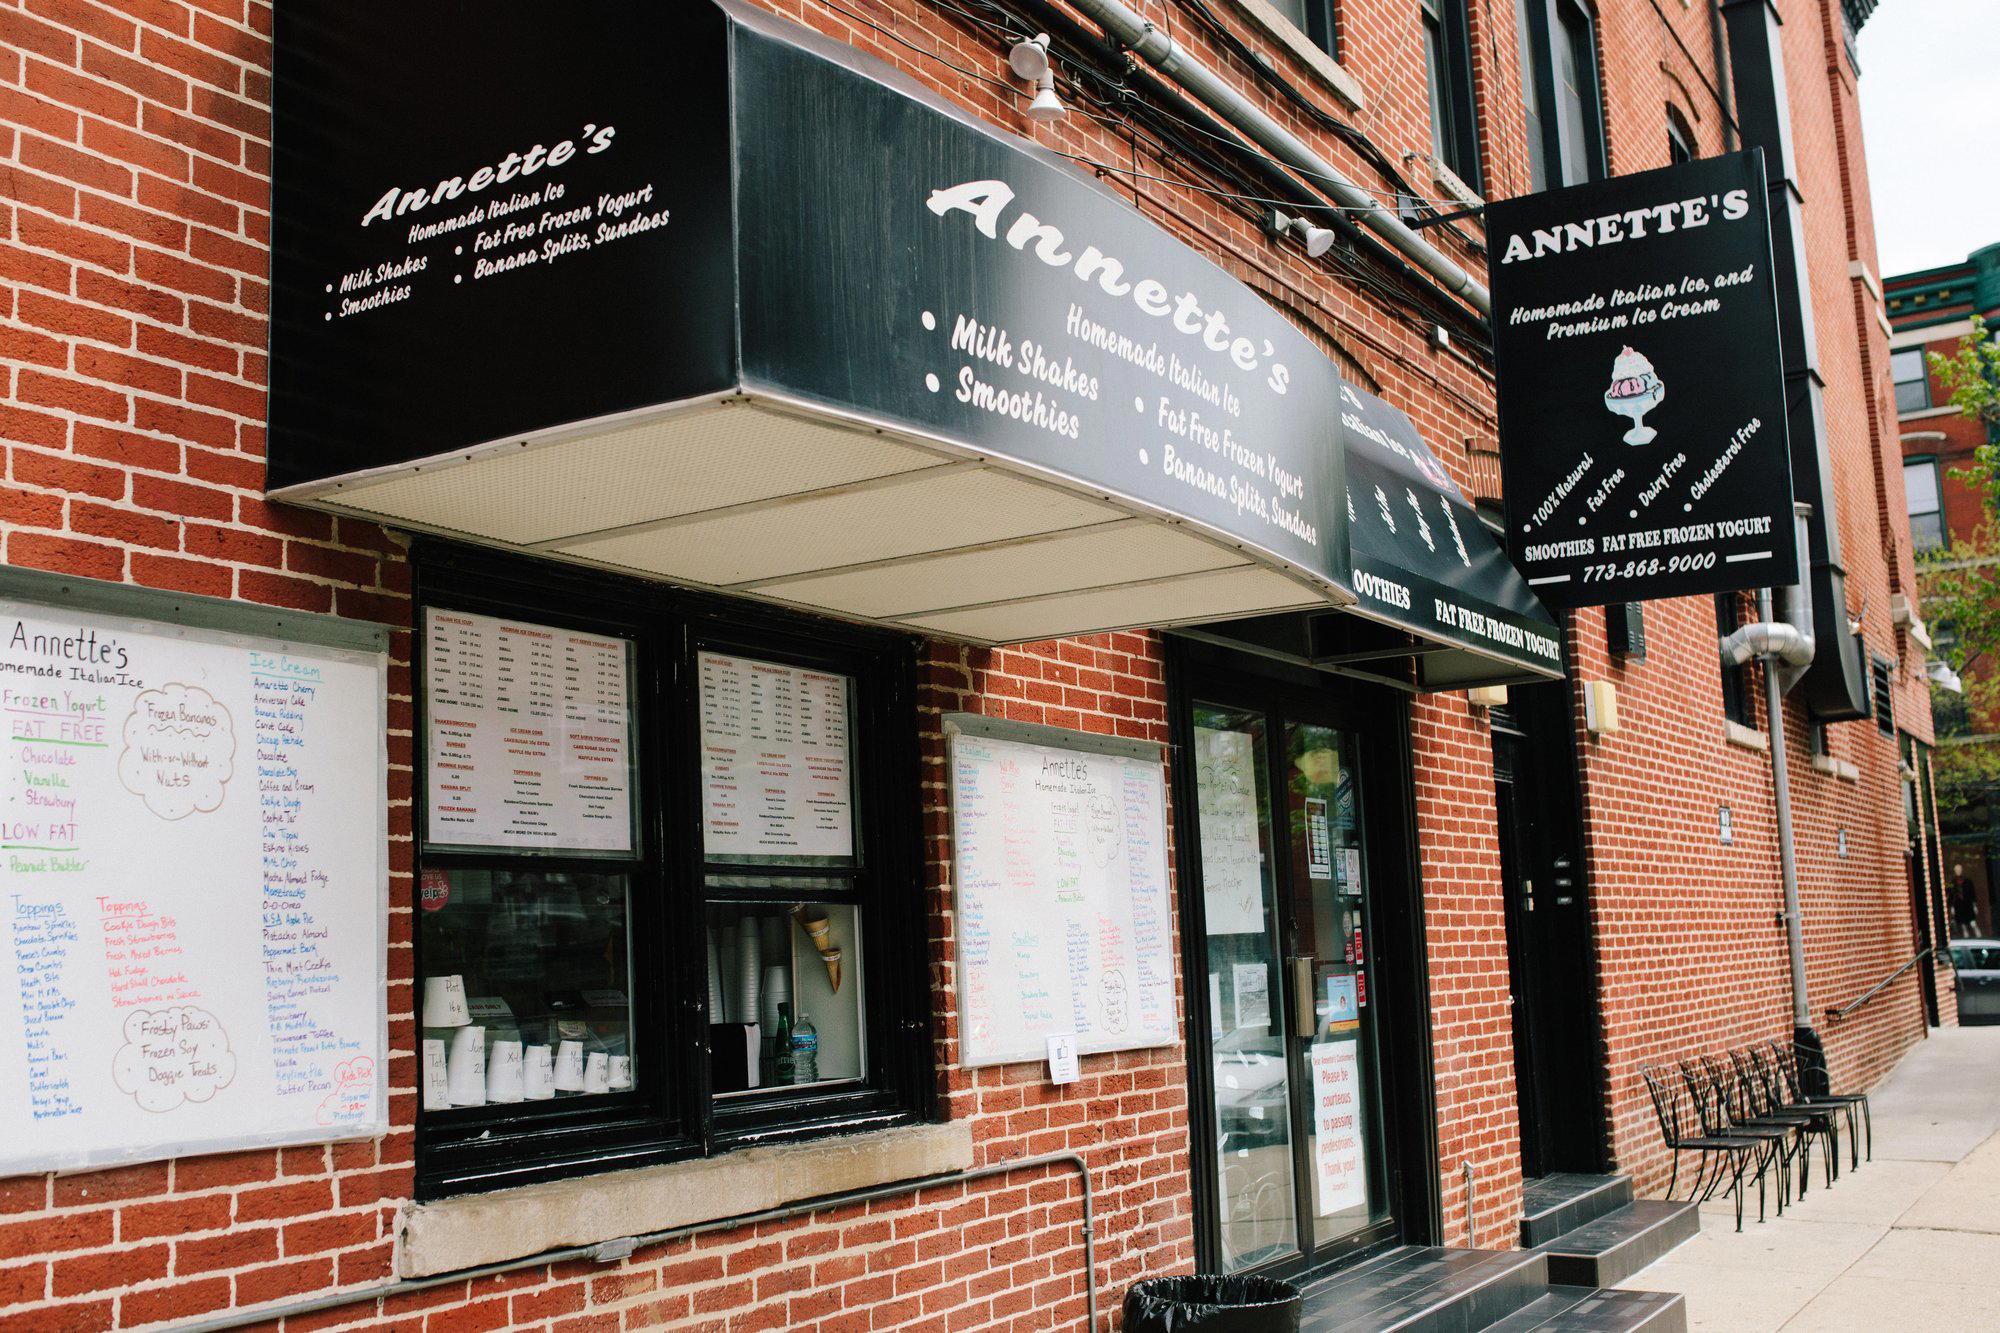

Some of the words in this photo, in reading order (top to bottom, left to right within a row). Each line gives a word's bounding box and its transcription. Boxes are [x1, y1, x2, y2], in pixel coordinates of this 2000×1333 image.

[361, 123, 615, 227] Annette's
[408, 210, 484, 243] Homemade
[487, 189, 541, 220] Italian
[543, 182, 565, 203] Ice
[474, 231, 501, 253] Fat
[503, 219, 535, 244] Free
[538, 203, 592, 234] Frozen
[597, 183, 653, 221] Yogurt
[1501, 189, 1749, 265] ANNETTE'S
[474, 249, 538, 279] Banana
[541, 233, 591, 263] Splits,
[594, 209, 670, 245] Sundaes
[340, 274, 372, 294] Milk
[375, 255, 428, 284] Shakes
[926, 179, 1291, 395] Annette's
[1509, 293, 1605, 326] Homemade
[1610, 284, 1676, 308] Italian
[1680, 276, 1709, 294] Ice,
[1714, 264, 1753, 289] and
[339, 284, 411, 317] Smoothies
[1547, 316, 1628, 341] Premium
[1632, 307, 1657, 326] Ice
[1660, 296, 1721, 321] Cream
[951, 314, 1013, 369] Milk
[1017, 339, 1099, 401] Shakes
[1066, 303, 1165, 377] Homemade
[1169, 353, 1220, 407] Italian
[1223, 384, 1240, 417] Ice
[955, 366, 1080, 440] Smoothies
[1158, 396, 1187, 436] Fat
[1189, 412, 1219, 452] Free
[1222, 429, 1265, 478] Frozen
[1267, 453, 1304, 500] Yogurt
[1689, 437, 1742, 500] Cholesterol
[1736, 416, 1761, 445] Free
[1163, 444, 1226, 499] Banana
[1229, 475, 1269, 525] Splits,
[1271, 497, 1317, 546] Sundaes
[1531, 492, 1560, 527] 100%
[1555, 452, 1594, 499] Natural
[1586, 490, 1603, 513] Fat
[1601, 467, 1626, 495] Free
[1638, 473, 1669, 507] Dairy
[1662, 452, 1687, 482] Free
[1524, 538, 1595, 562] SMOOTHIES
[1602, 533, 1626, 552] FAT
[1628, 529, 1661, 549] FREE
[1663, 523, 1715, 545] FROZEN
[1717, 516, 1772, 539] YOGURT
[1583, 551, 1717, 583] 773-868-9000
[1353, 568, 1411, 610] OOTHIES
[9, 621, 129, 669] Annette's
[1435, 598, 1457, 626] FAT
[1458, 606, 1486, 636] FREE
[1486, 617, 1525, 649] FROZEN
[1524, 630, 1560, 661] YOGURT
[0, 661, 62, 679] omemade
[69, 667, 116, 684] Italian
[116, 673, 144, 689] Ice
[250, 652, 275, 669] Ice
[281, 656, 321, 680] Cream
[3, 689, 58, 709] Frozen
[64, 690, 107, 721] Yogurt
[12, 720, 44, 738] FAT
[60, 722, 105, 742] FREE
[21, 747, 76, 766] Chocolate
[1042, 755, 1088, 781] Annette's
[24, 770, 70, 787] Vanilla
[156, 769, 191, 787] Nuts
[2, 823, 39, 840] LOW
[49, 823, 78, 841] FAT
[10, 894, 64, 922] Toppings
[96, 896, 148, 918] Toppings
[141, 1020, 178, 1042] Frosty
[141, 1044, 175, 1059] Frozen
[178, 1039, 200, 1059] Soy
[148, 1066, 184, 1086] Doggie
[188, 1060, 218, 1077] Treats
[1322, 1069, 1339, 1085] Please
[1323, 1092, 1351, 1108] courteous
[1331, 1114, 1353, 1133] passing
